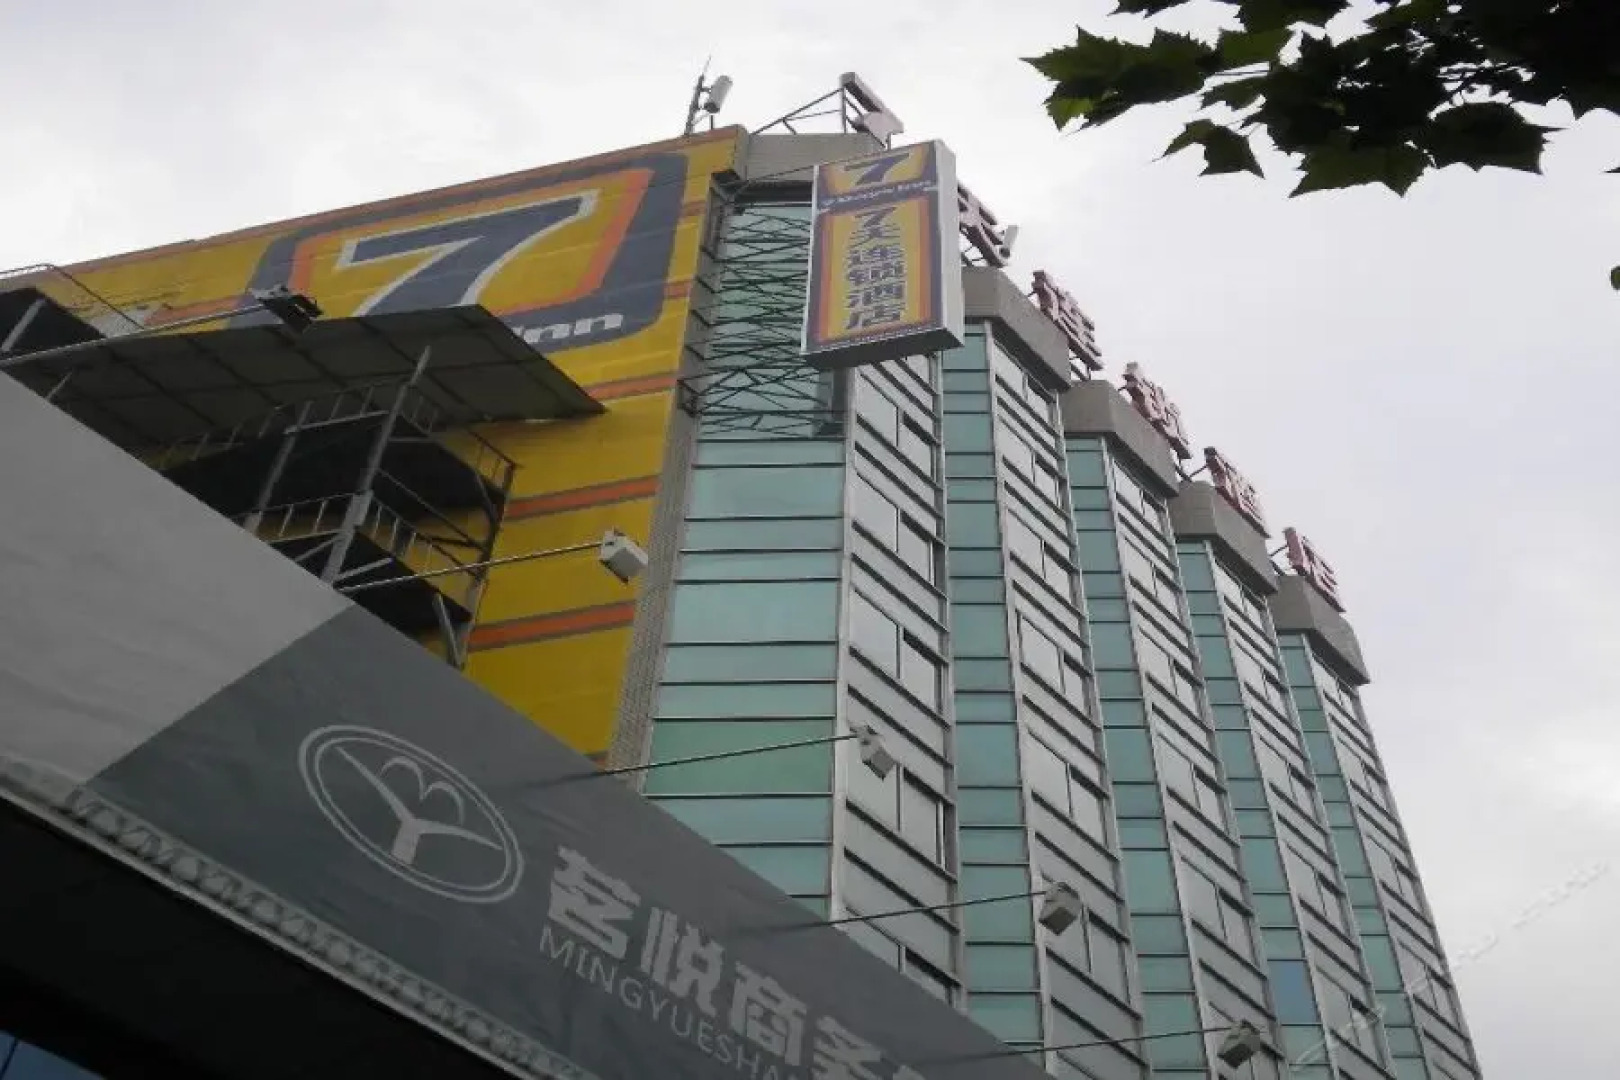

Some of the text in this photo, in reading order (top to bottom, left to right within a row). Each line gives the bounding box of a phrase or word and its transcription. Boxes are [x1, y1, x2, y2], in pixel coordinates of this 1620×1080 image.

[843, 152, 911, 187] 7
[334, 187, 599, 317] 7
[538, 923, 804, 1080] MINGYUESHA
